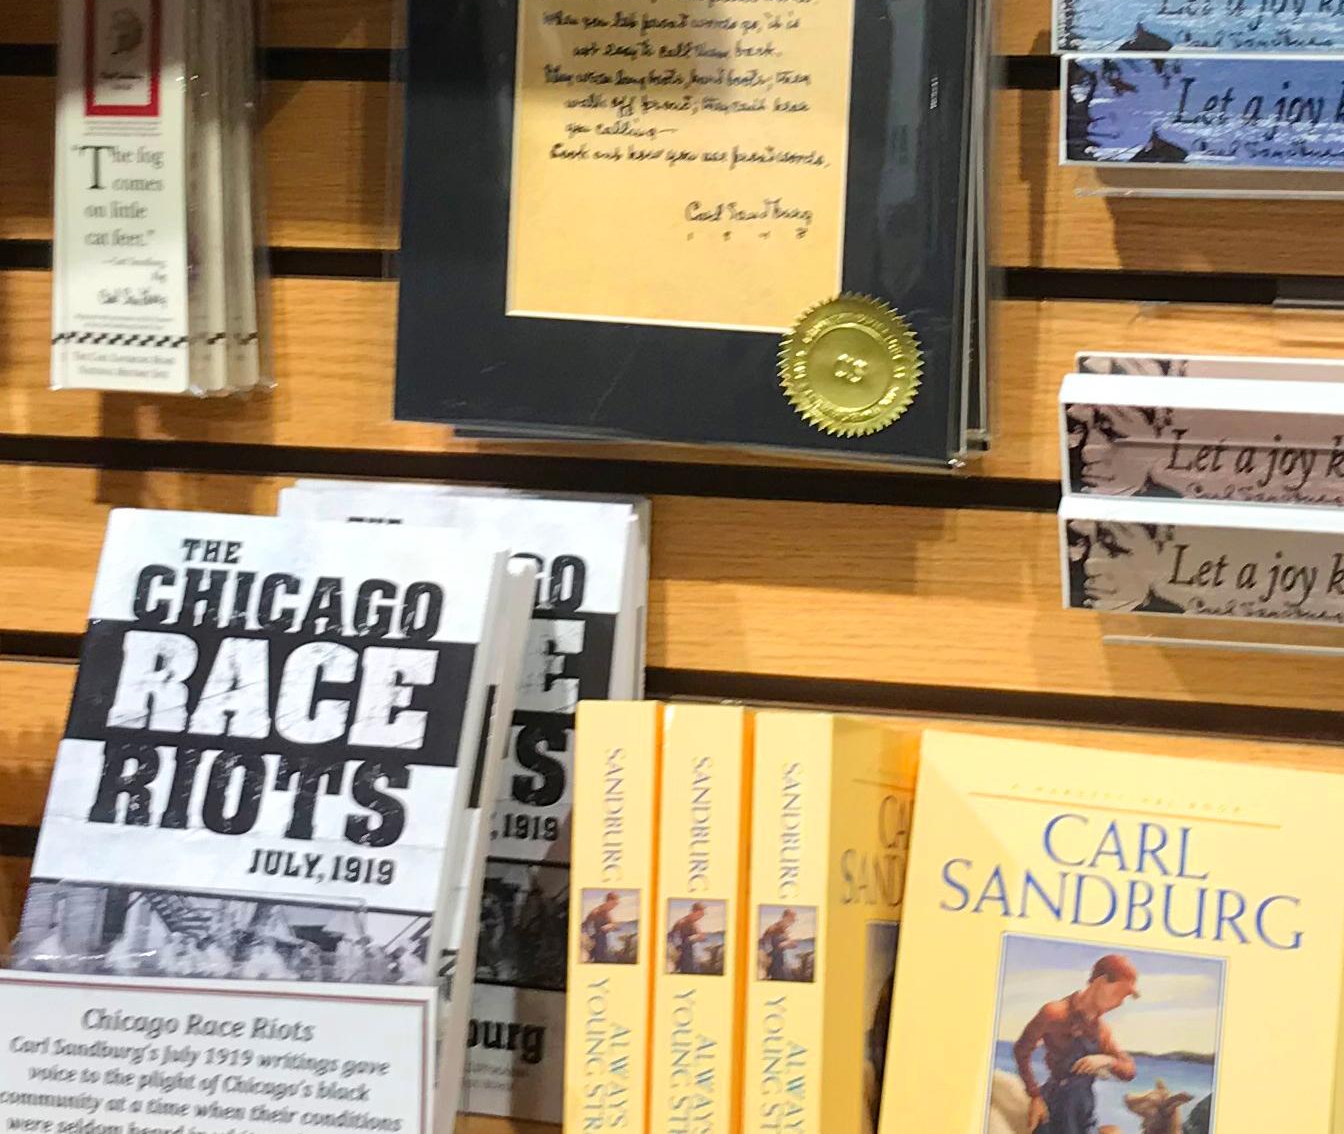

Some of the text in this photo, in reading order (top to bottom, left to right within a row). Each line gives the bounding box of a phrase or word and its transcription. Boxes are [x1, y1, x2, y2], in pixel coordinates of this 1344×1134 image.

[1173, 78, 1233, 126] Let
[1241, 95, 1262, 125] a
[1265, 81, 1326, 138] joy
[182, 538, 242, 563] THE
[1168, 545, 1229, 587] Let
[1238, 559, 1257, 588] a
[1260, 553, 1316, 606] joy
[133, 564, 445, 641] CHICAGO
[106, 631, 439, 749] RACE
[89, 741, 412, 848] RIOTS
[1044, 813, 1209, 881] CARL
[939, 858, 1304, 949] SANDBURG
[81, 1008, 315, 1042] Chicago Race Riots
[9, 1036, 50, 1054] Carl
[160, 1045, 201, 1067] July
[205, 1048, 253, 1066] 1919
[257, 1052, 339, 1076] writings
[341, 1060, 390, 1078] gave
[28, 1066, 77, 1082] voice
[80, 1068, 100, 1084] to
[103, 1068, 135, 1085] the
[137, 1070, 196, 1093] plight
[198, 1074, 221, 1096] of
[315, 1081, 370, 1100] black
[105, 1098, 126, 1111] at
[129, 1101, 143, 1112] a
[146, 1098, 190, 1115] time
[194, 1101, 246, 1120] when
[249, 1104, 297, 1123] their
[300, 1110, 402, 1131] conditions
